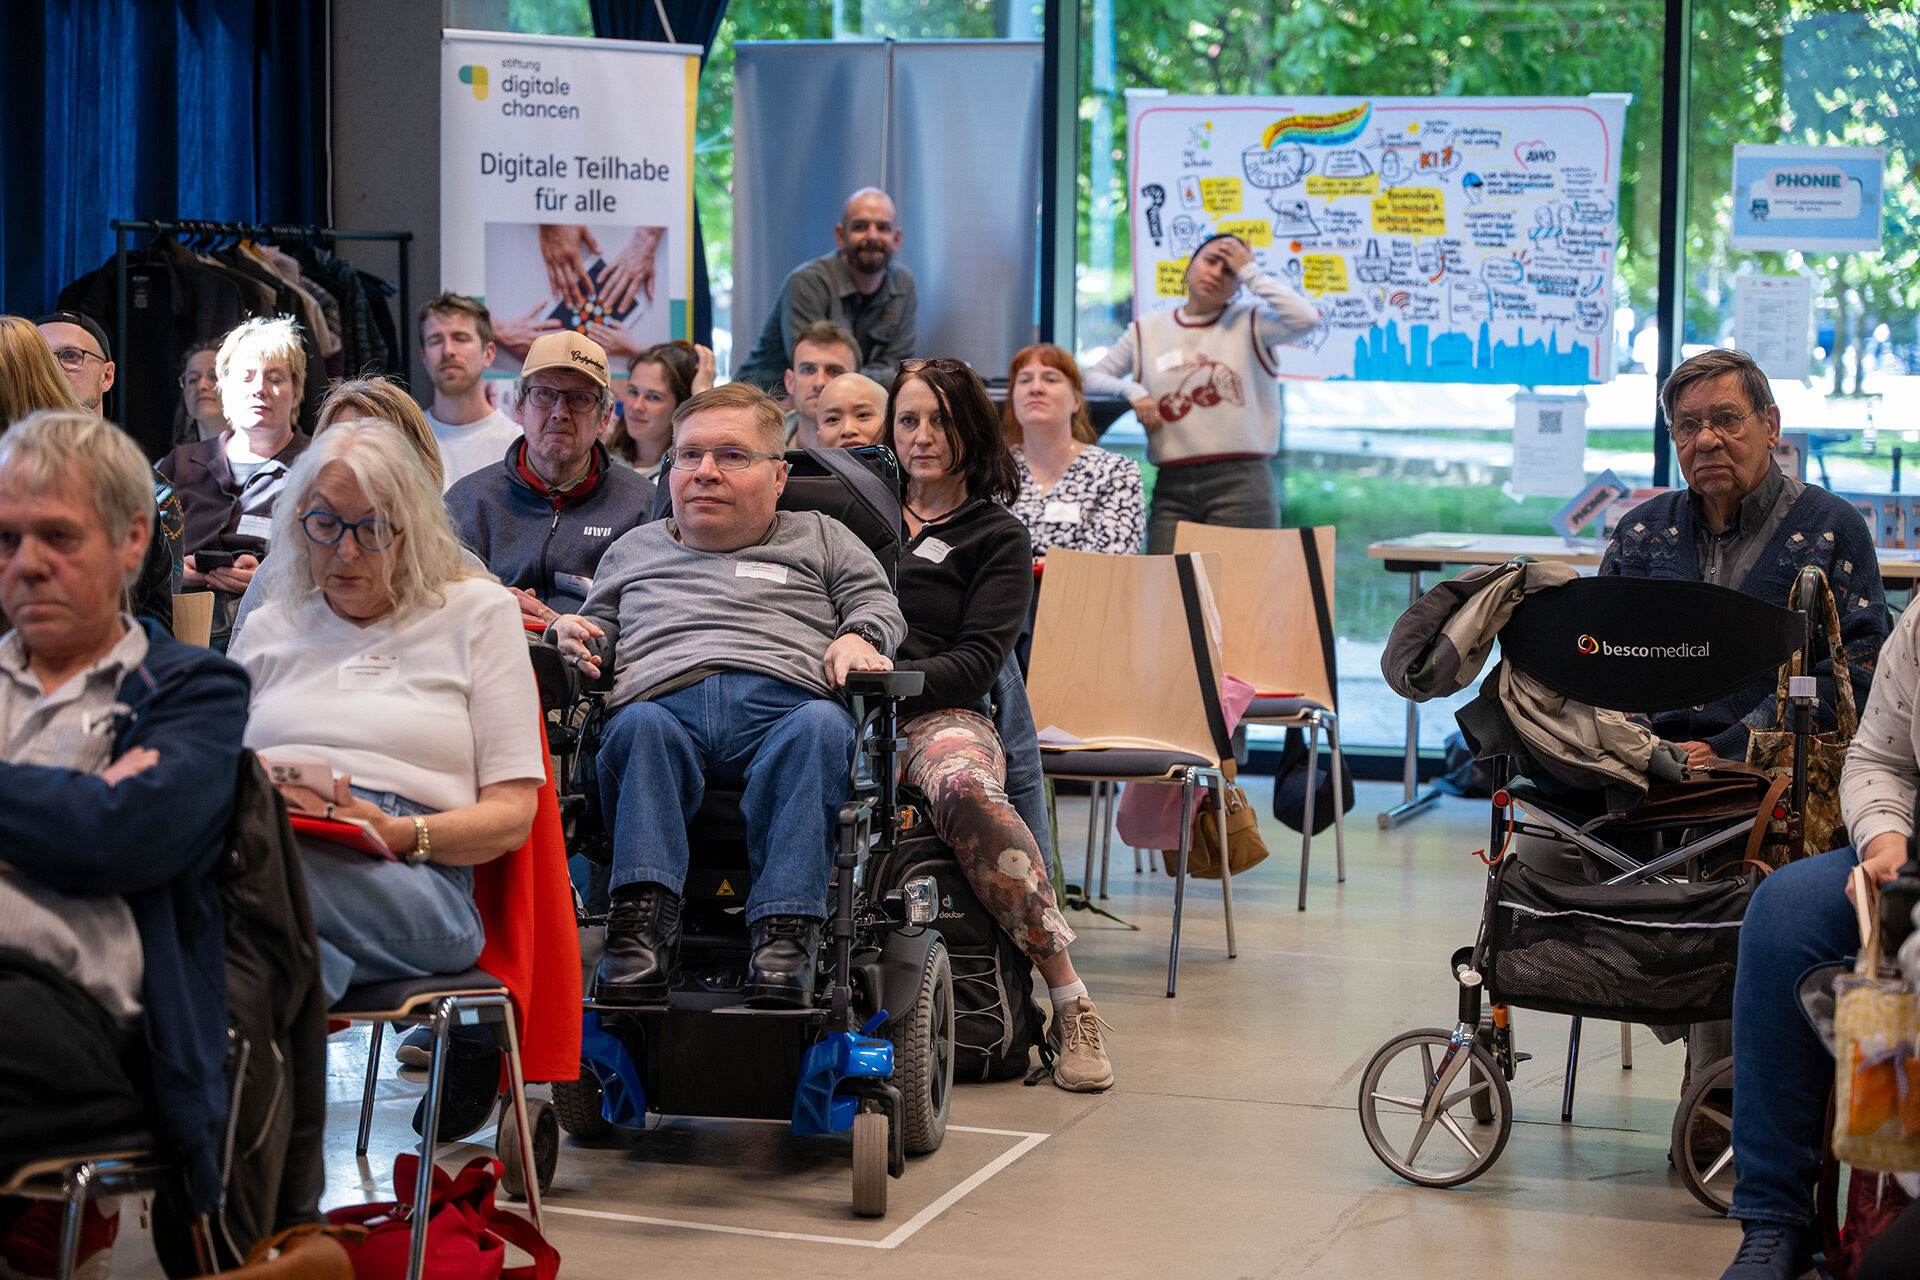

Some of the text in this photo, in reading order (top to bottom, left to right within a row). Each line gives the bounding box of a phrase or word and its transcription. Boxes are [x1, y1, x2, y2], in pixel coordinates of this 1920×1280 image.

[501, 58, 541, 72] stiftung
[501, 76, 571, 98] digitale
[501, 100, 580, 119] chancen
[480, 152, 670, 183] Digitale Teilhabe
[1775, 173, 1842, 188] PHONIE
[535, 187, 617, 212] für alle
[938, 910, 965, 919] deuter
